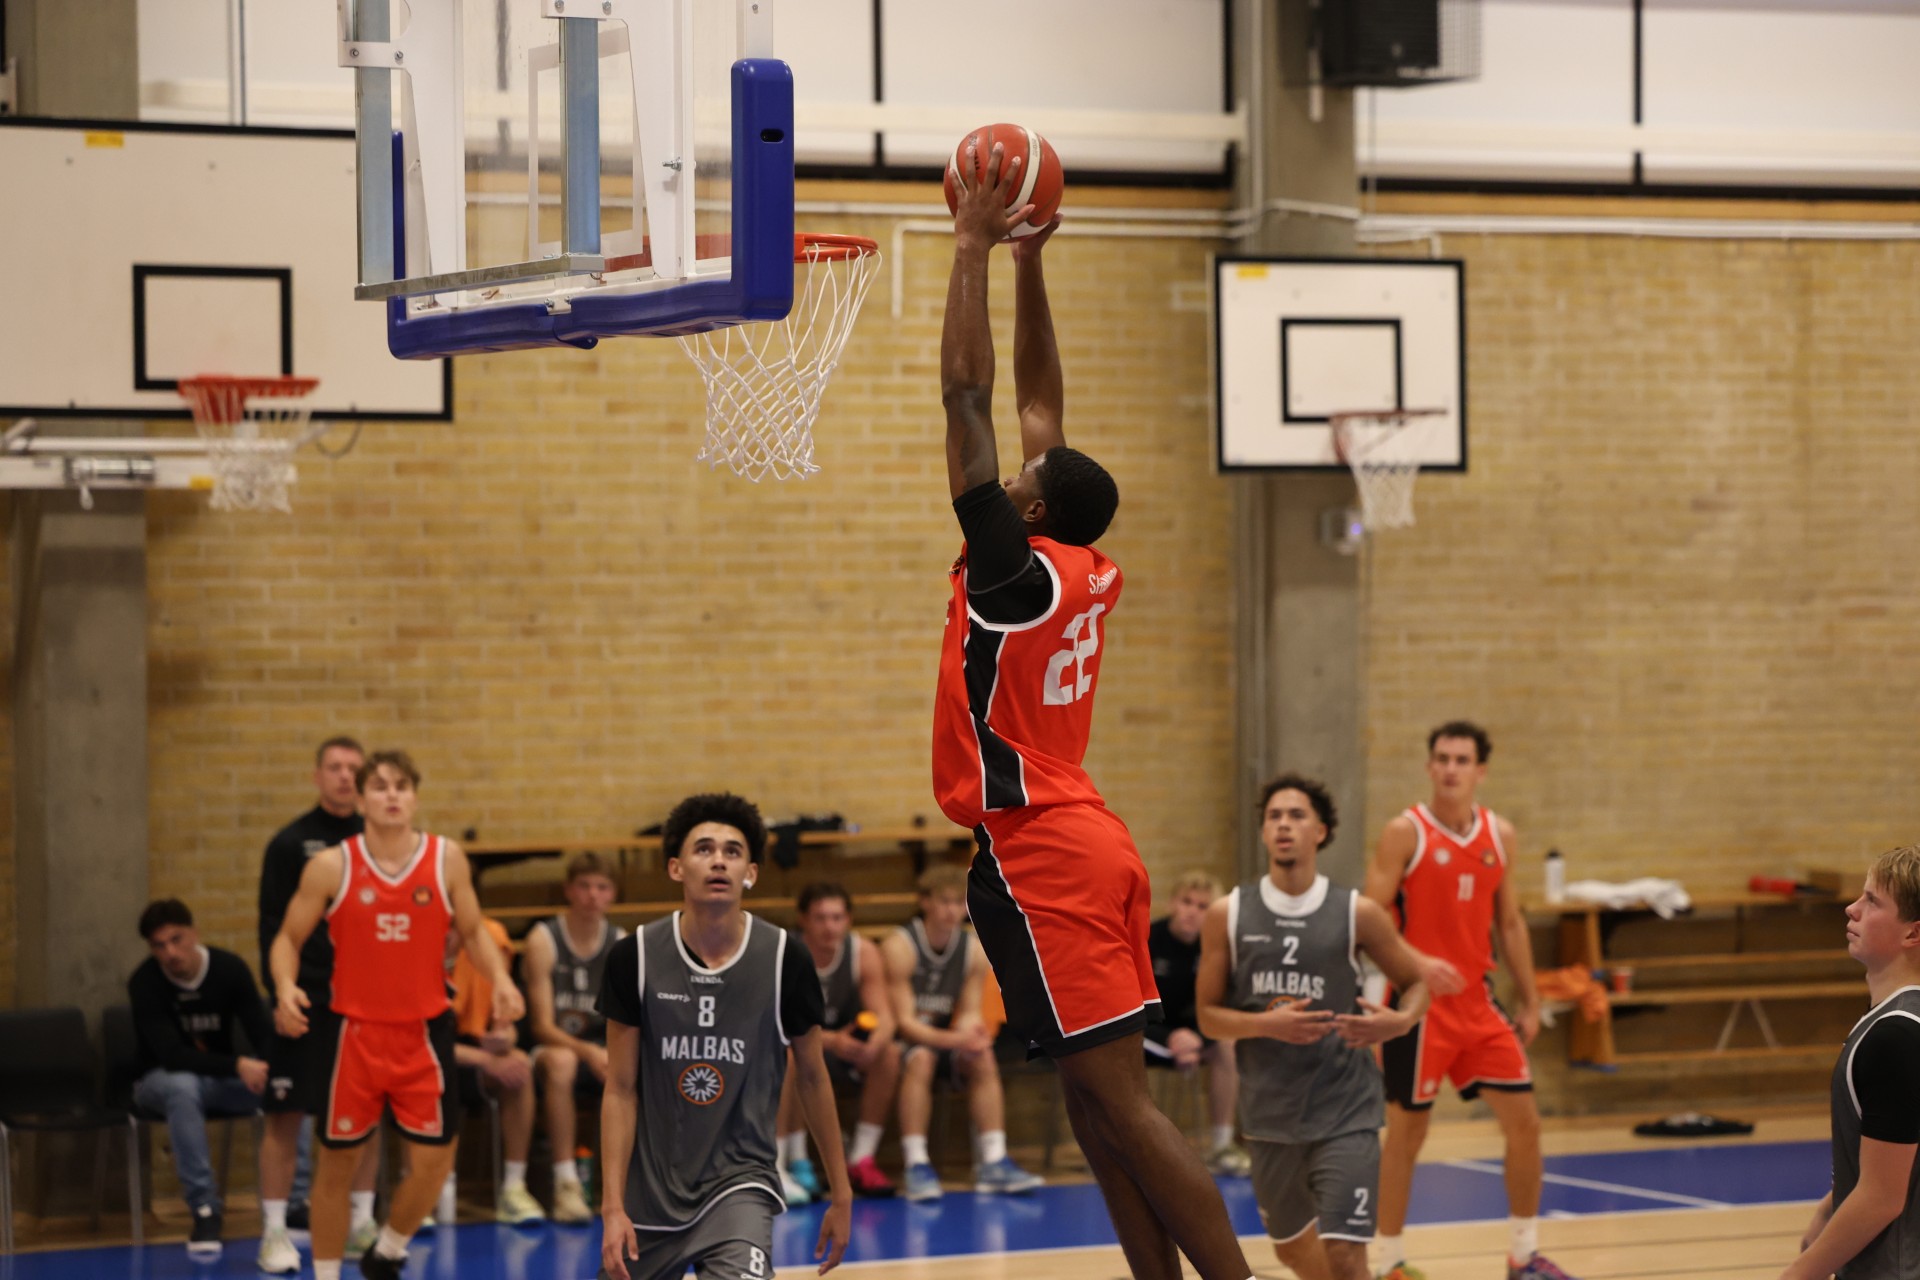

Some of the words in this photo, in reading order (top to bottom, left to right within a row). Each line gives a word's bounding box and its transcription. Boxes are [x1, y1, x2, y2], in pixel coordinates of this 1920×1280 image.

[376, 913, 411, 941] 52
[1282, 935, 1299, 965] 2
[698, 995, 715, 1027] 8
[661, 1035, 745, 1065] MALBAS
[1354, 1187, 1368, 1216] 2
[749, 1245, 765, 1277] 8
